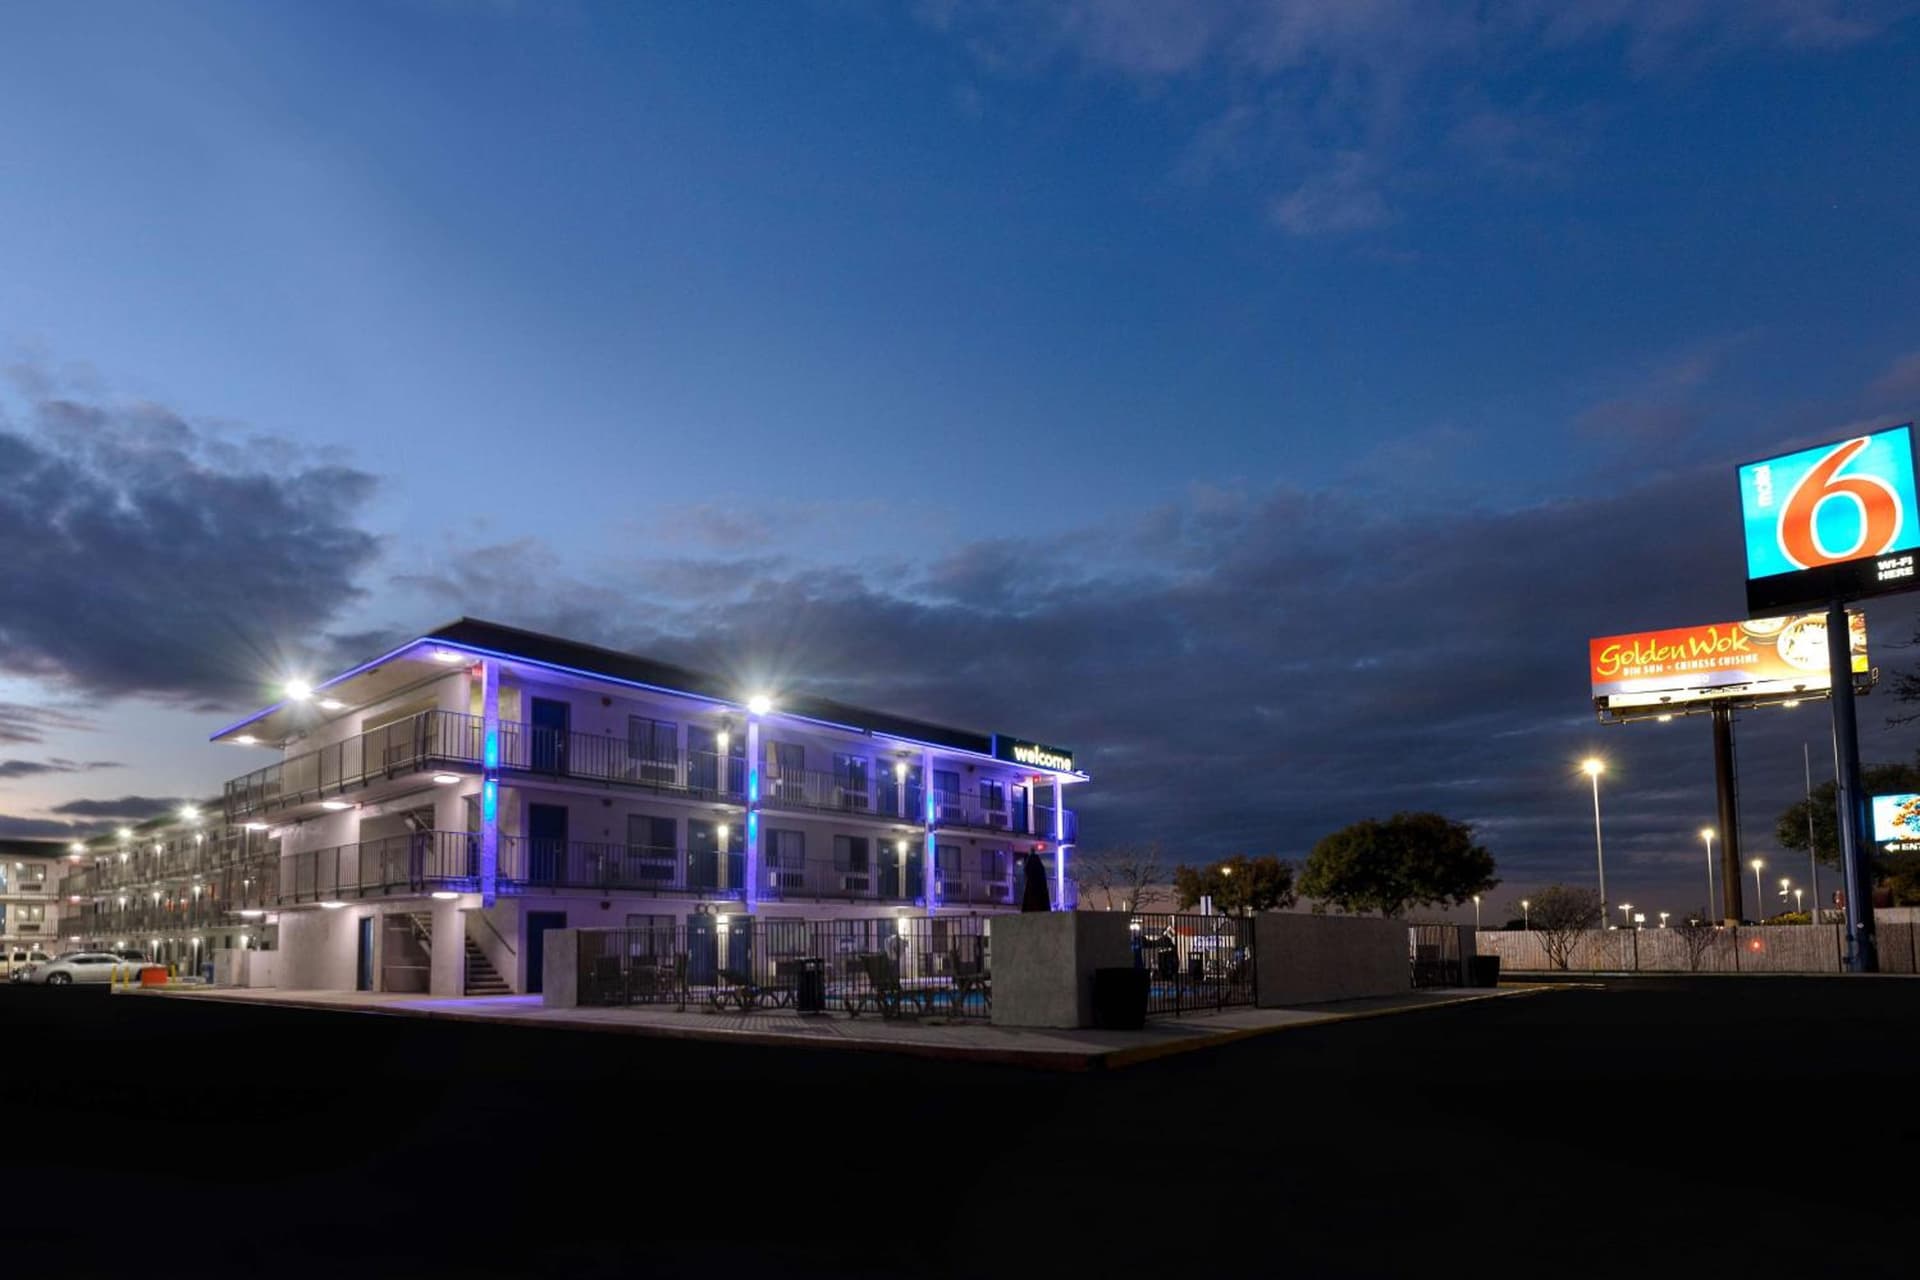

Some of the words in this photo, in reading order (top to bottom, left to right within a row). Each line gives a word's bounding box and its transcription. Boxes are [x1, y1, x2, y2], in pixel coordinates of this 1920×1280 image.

[1777, 436, 1903, 569] 6
[1878, 556, 1913, 570] WI-FI
[1878, 566, 1914, 581] HERE
[1597, 638, 1686, 675] Golden
[1690, 627, 1749, 656] Wok
[1014, 744, 1072, 771] welcome
